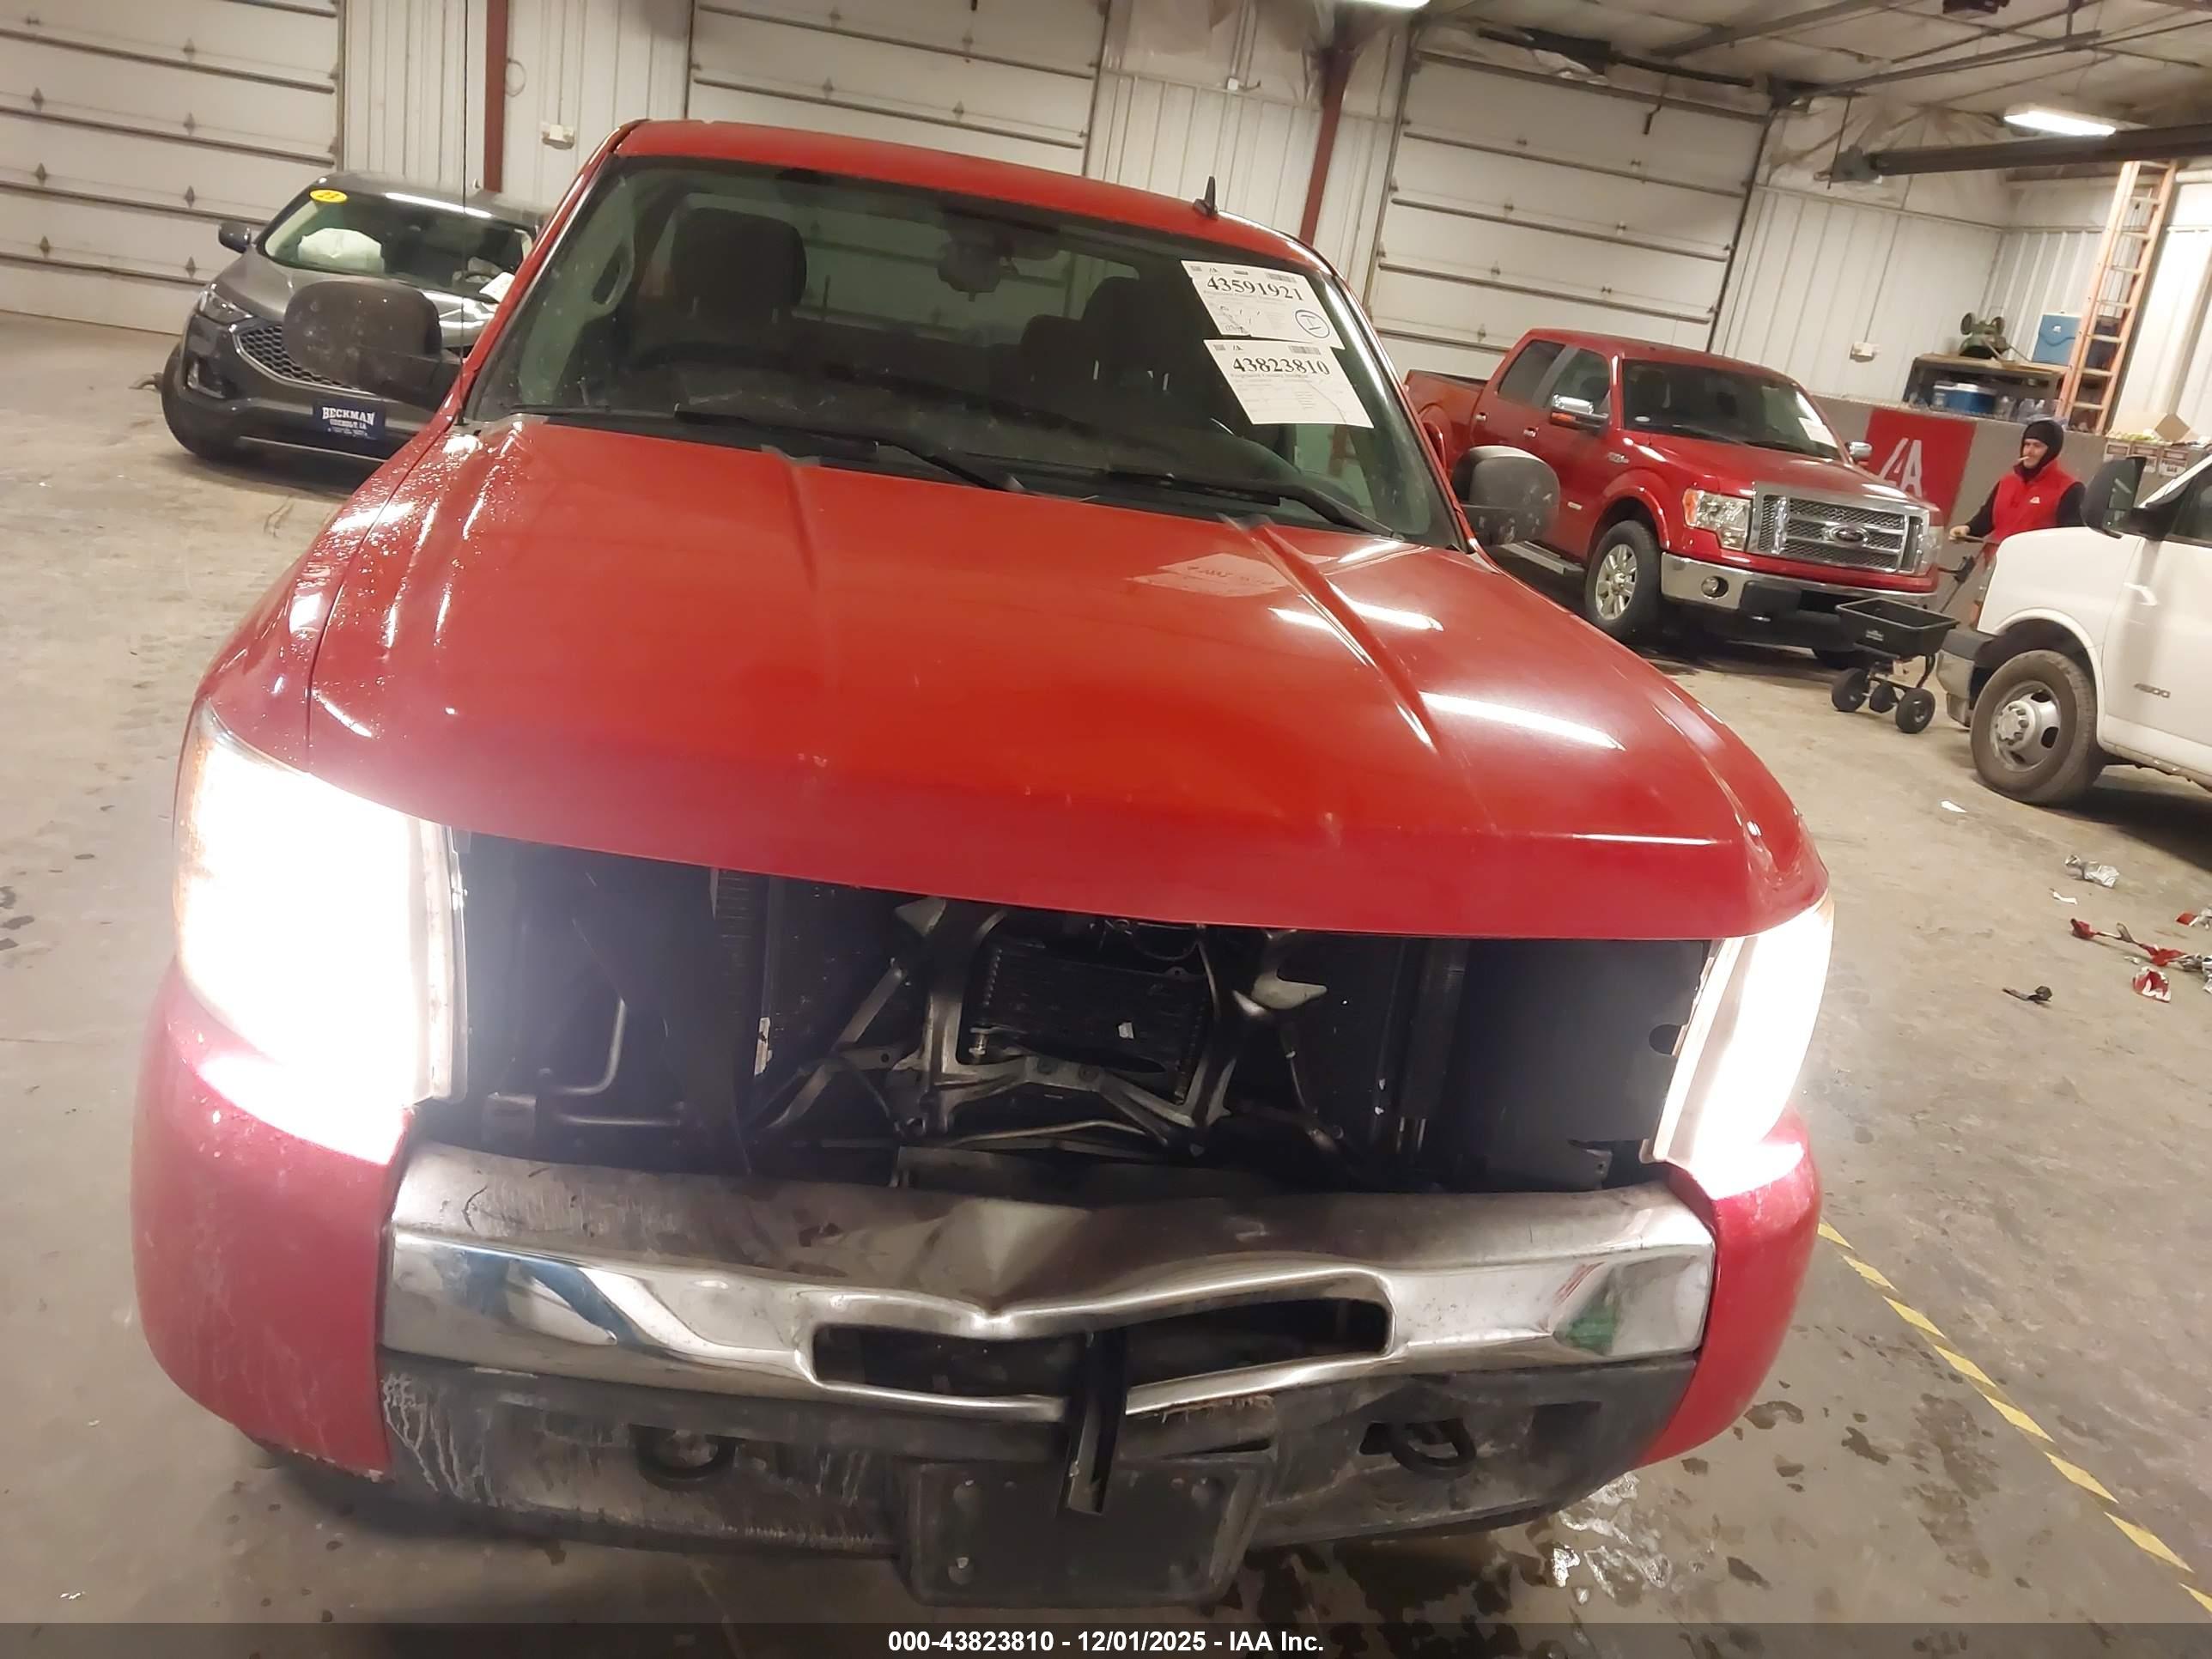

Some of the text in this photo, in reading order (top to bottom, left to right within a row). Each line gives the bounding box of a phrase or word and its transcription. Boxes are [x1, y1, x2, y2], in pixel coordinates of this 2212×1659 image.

[1207, 276, 1304, 301] 43591921
[1233, 357, 1330, 375] 43823810
[322, 407, 375, 426] BECKMAN
